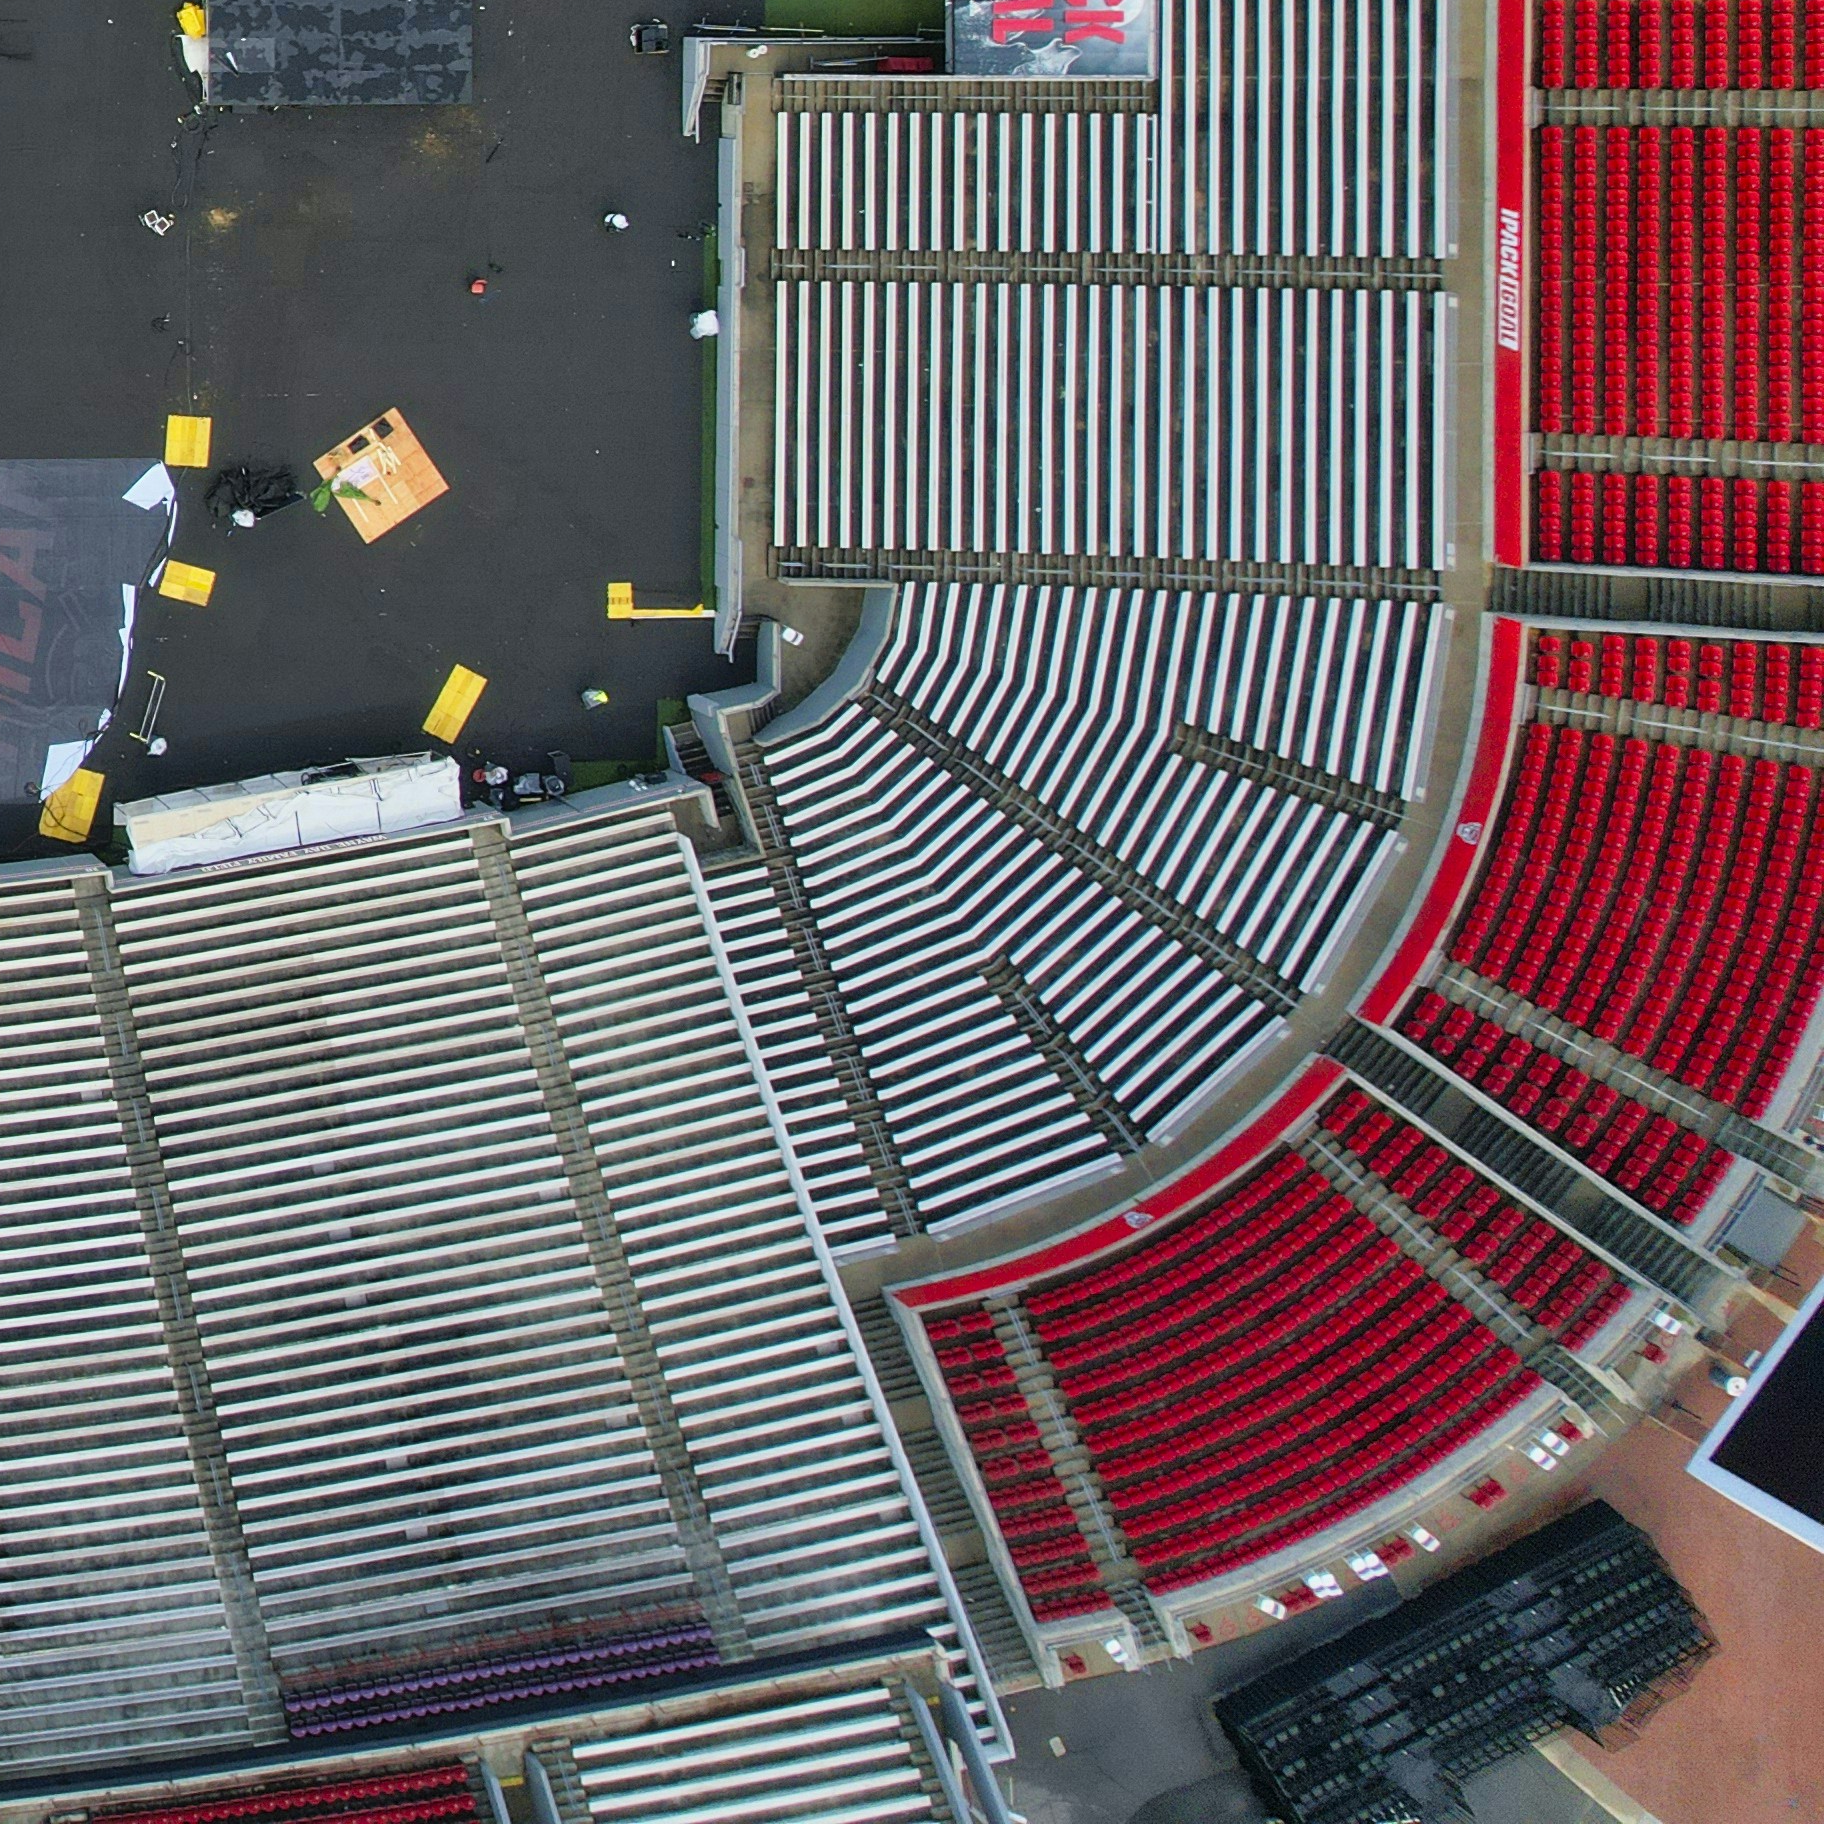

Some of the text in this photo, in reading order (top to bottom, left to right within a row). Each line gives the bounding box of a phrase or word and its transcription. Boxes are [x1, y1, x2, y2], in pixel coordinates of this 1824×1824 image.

[200, 833, 387, 874] WAYNE DAY FAMILY FIELD
